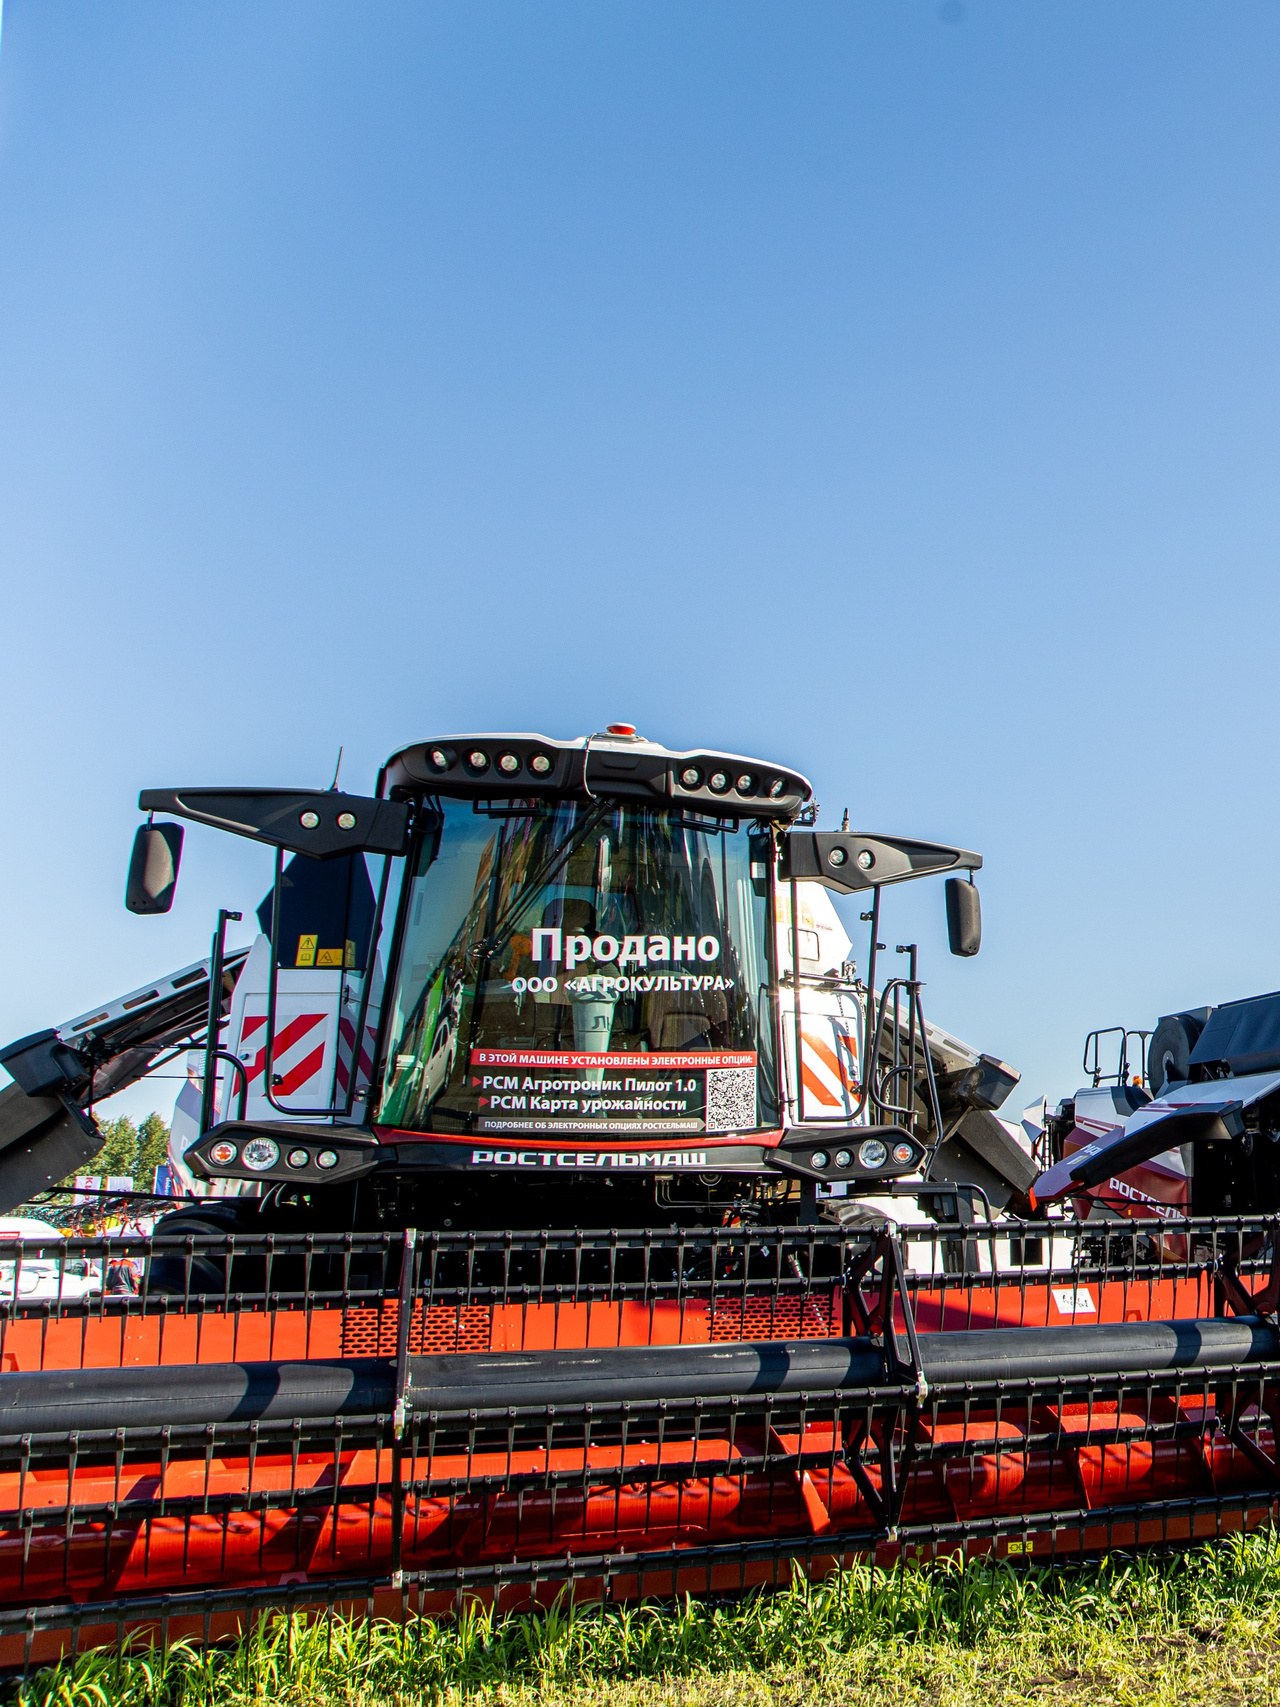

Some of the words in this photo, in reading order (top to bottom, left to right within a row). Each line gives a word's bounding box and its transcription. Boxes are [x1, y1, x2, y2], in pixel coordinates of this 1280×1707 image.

[531, 928, 720, 970] Продано
[511, 976, 558, 993] ООО
[564, 975, 735, 993] «АГРОКУЛЬТУРА»
[479, 1053, 487, 1062] В
[488, 1053, 517, 1064] ЭТОЙ
[519, 1054, 569, 1065] МАШИНЕ
[571, 1055, 650, 1066] УСТАНОВЛЕНЫ
[651, 1056, 721, 1066] ЭЛЕКТРОННЫЕ
[721, 1055, 753, 1067] ОПЦИИ:
[482, 1075, 519, 1090] РСМ
[521, 1076, 622, 1094] Агротроник
[624, 1077, 673, 1093] Пилот
[676, 1078, 697, 1092] 1.0
[490, 1095, 527, 1110] РСМ
[530, 1095, 579, 1113] Карта
[581, 1096, 687, 1114] урожайности
[484, 1120, 534, 1130] ПОДРОБНЕЕ
[534, 1121, 547, 1129] ОБ
[547, 1121, 608, 1130] ЭЛЕКТРОННЫХ
[608, 1122, 641, 1131] ОПЦИЯХ
[642, 1122, 698, 1130] РОСТСЕЛЬМАШ
[472, 1150, 707, 1167] РОСТСЕЛЬМАШ
